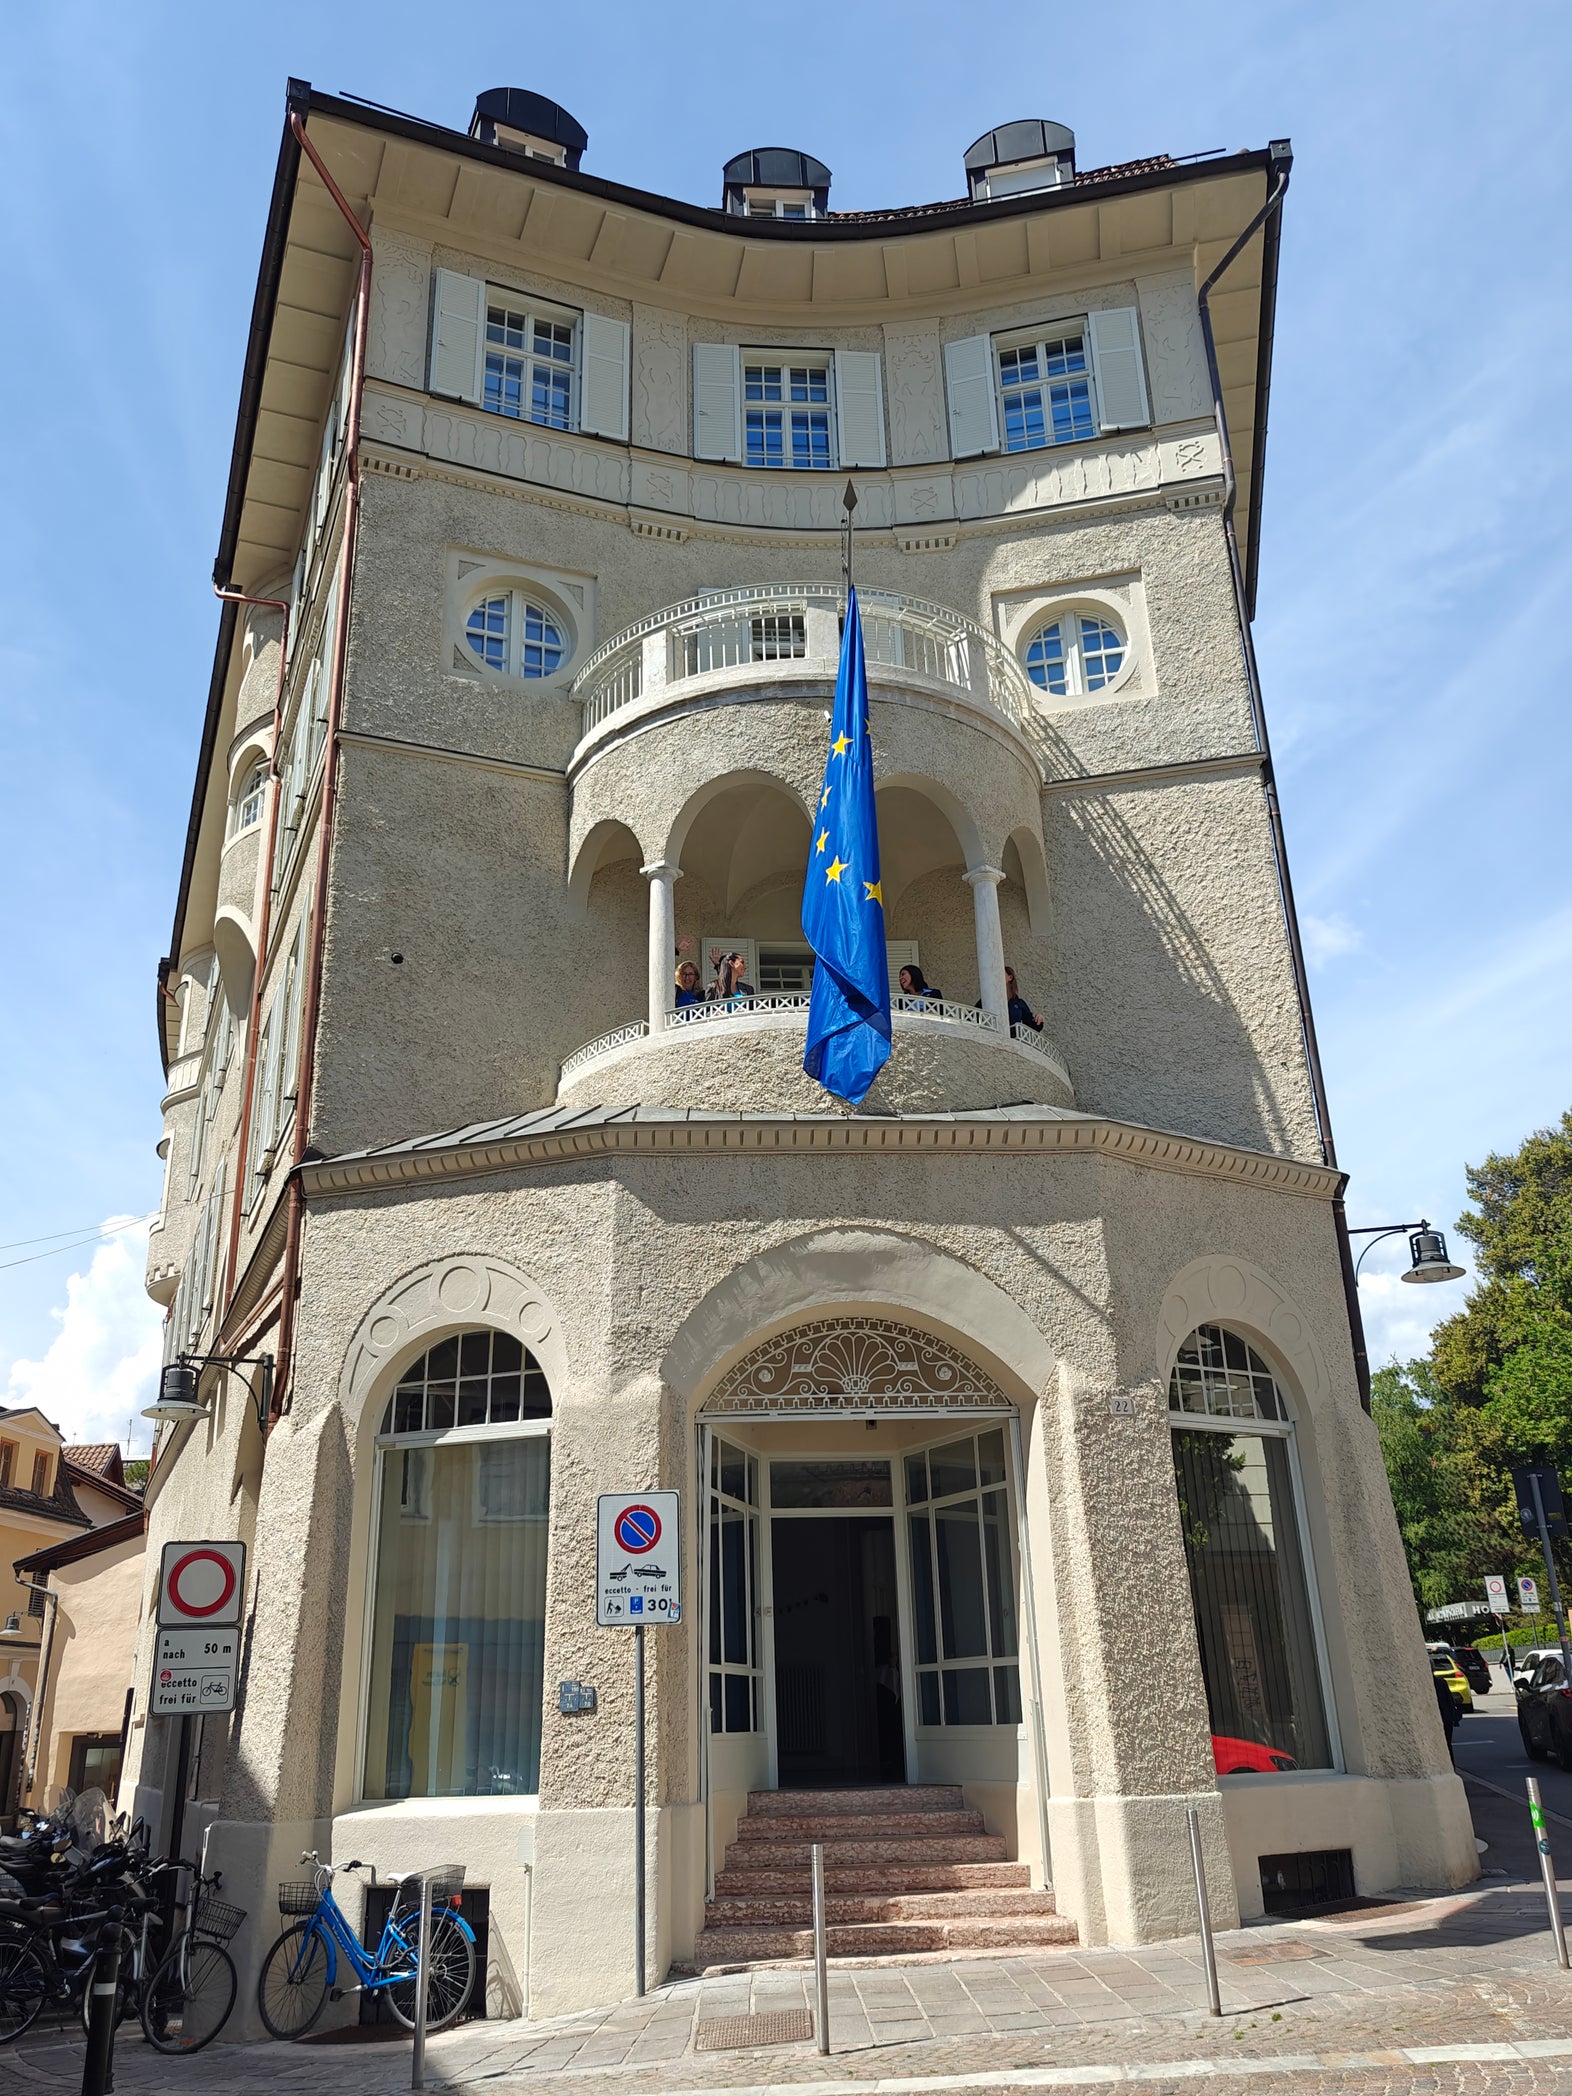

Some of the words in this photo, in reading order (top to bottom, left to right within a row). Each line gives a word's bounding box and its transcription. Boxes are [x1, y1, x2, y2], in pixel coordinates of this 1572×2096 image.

[1114, 1400, 1129, 1412] 22
[604, 1586, 632, 1595] eccetto
[643, 1584, 657, 1593] frei
[661, 1584, 672, 1592] für
[1472, 1605, 1490, 1614] HO
[164, 1639, 170, 1647] a
[204, 1643, 218, 1654] 50
[223, 1645, 232, 1654] m
[163, 1649, 186, 1659] nach
[159, 1694, 178, 1705] frei
[181, 1693, 197, 1704] für
